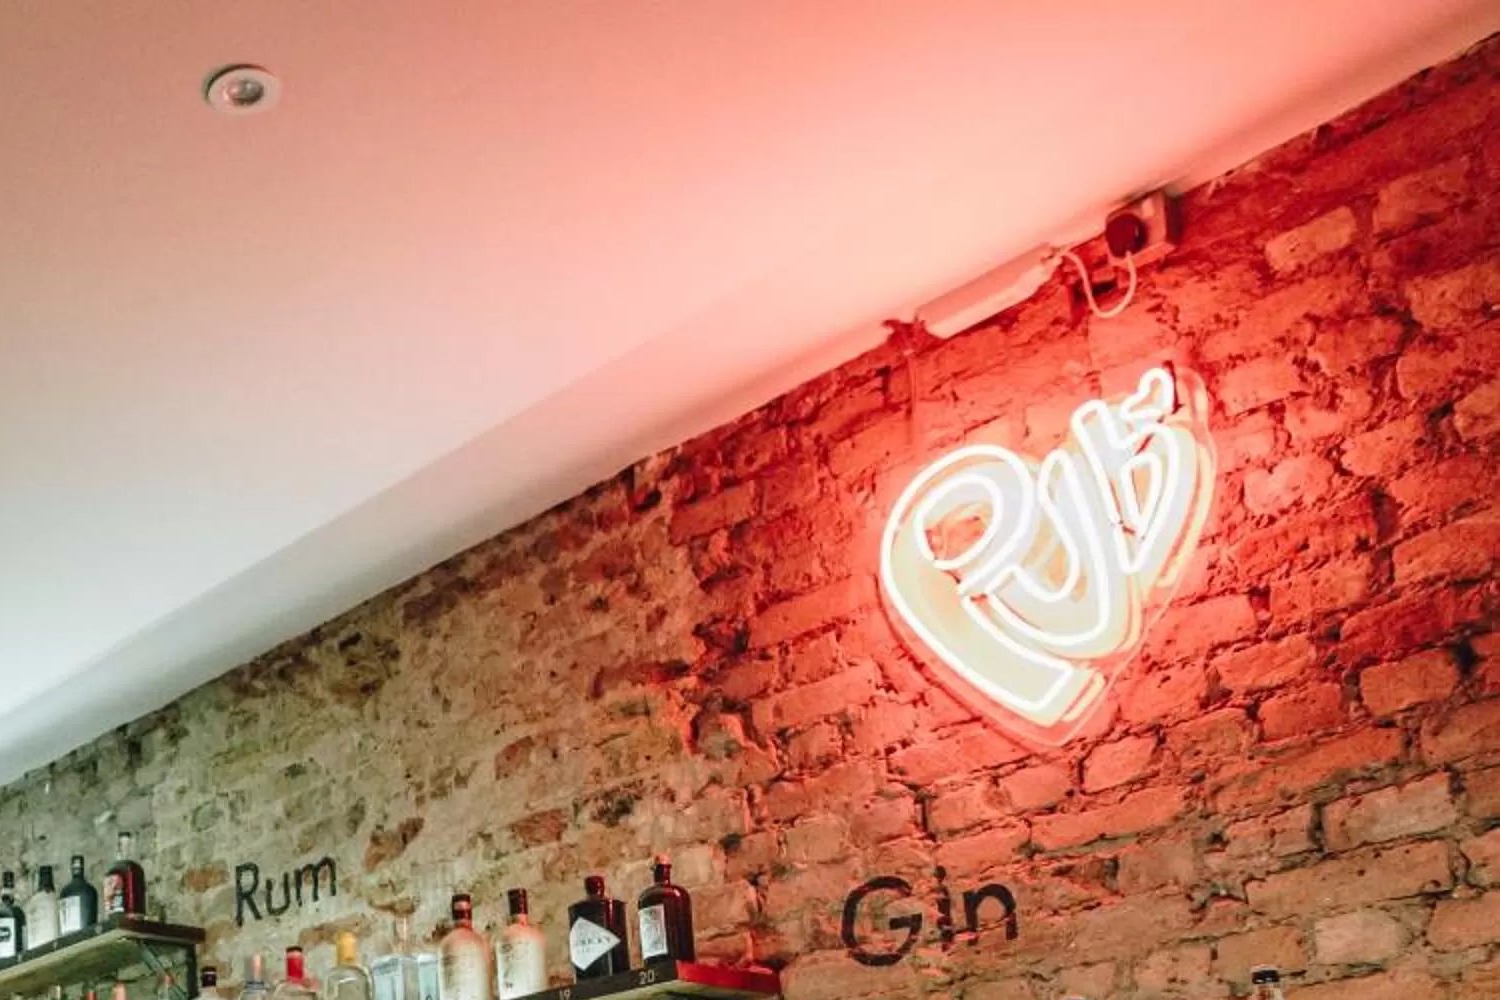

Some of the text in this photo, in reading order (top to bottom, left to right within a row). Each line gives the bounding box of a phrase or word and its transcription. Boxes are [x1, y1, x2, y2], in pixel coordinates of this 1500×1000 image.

[235, 856, 337, 926] Rum
[840, 866, 1018, 967] Gin
[639, 969, 655, 985] 20
